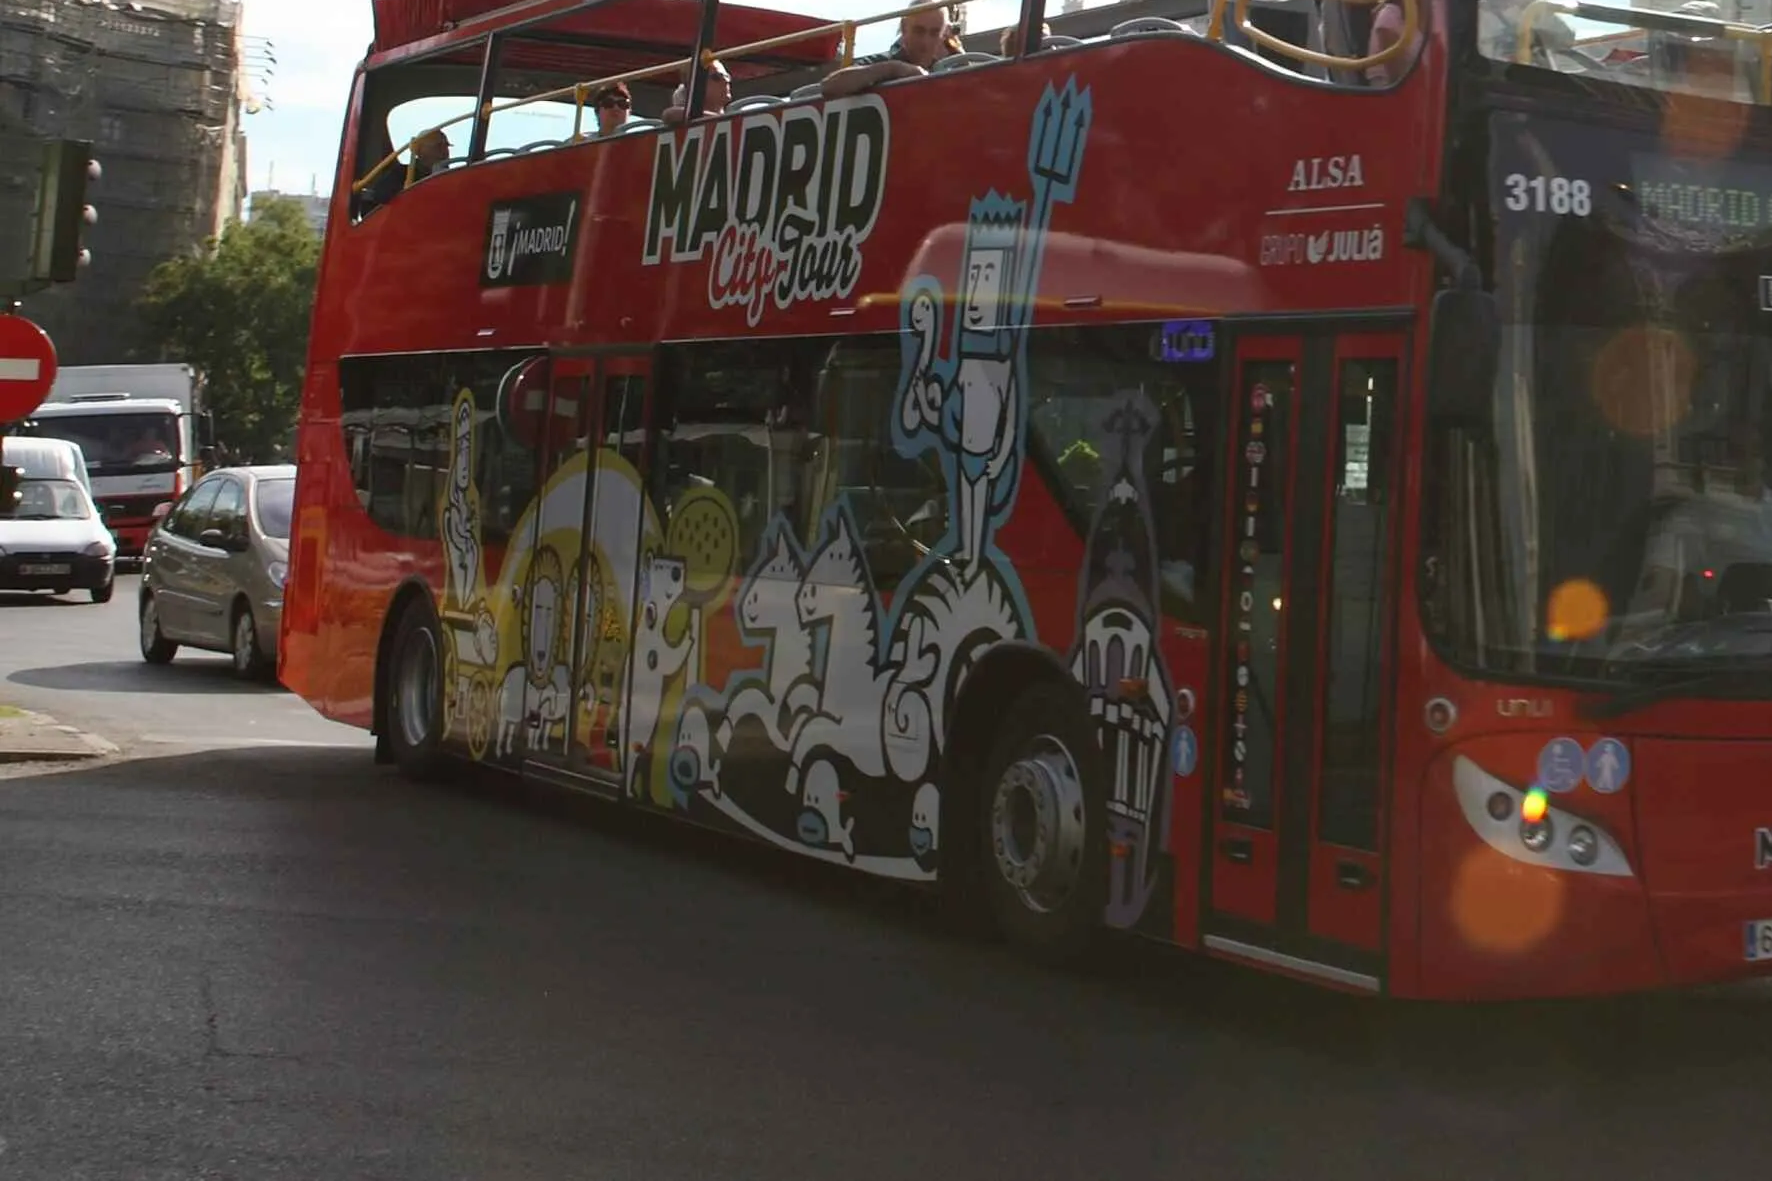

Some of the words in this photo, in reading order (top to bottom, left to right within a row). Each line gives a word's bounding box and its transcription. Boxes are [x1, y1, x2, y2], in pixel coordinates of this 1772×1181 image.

[642, 93, 890, 265] MADRID
[1287, 154, 1364, 191] ALSA
[1504, 173, 1592, 217] 3188
[1639, 181, 1758, 227] MADRID
[775, 208, 862, 309] Tour
